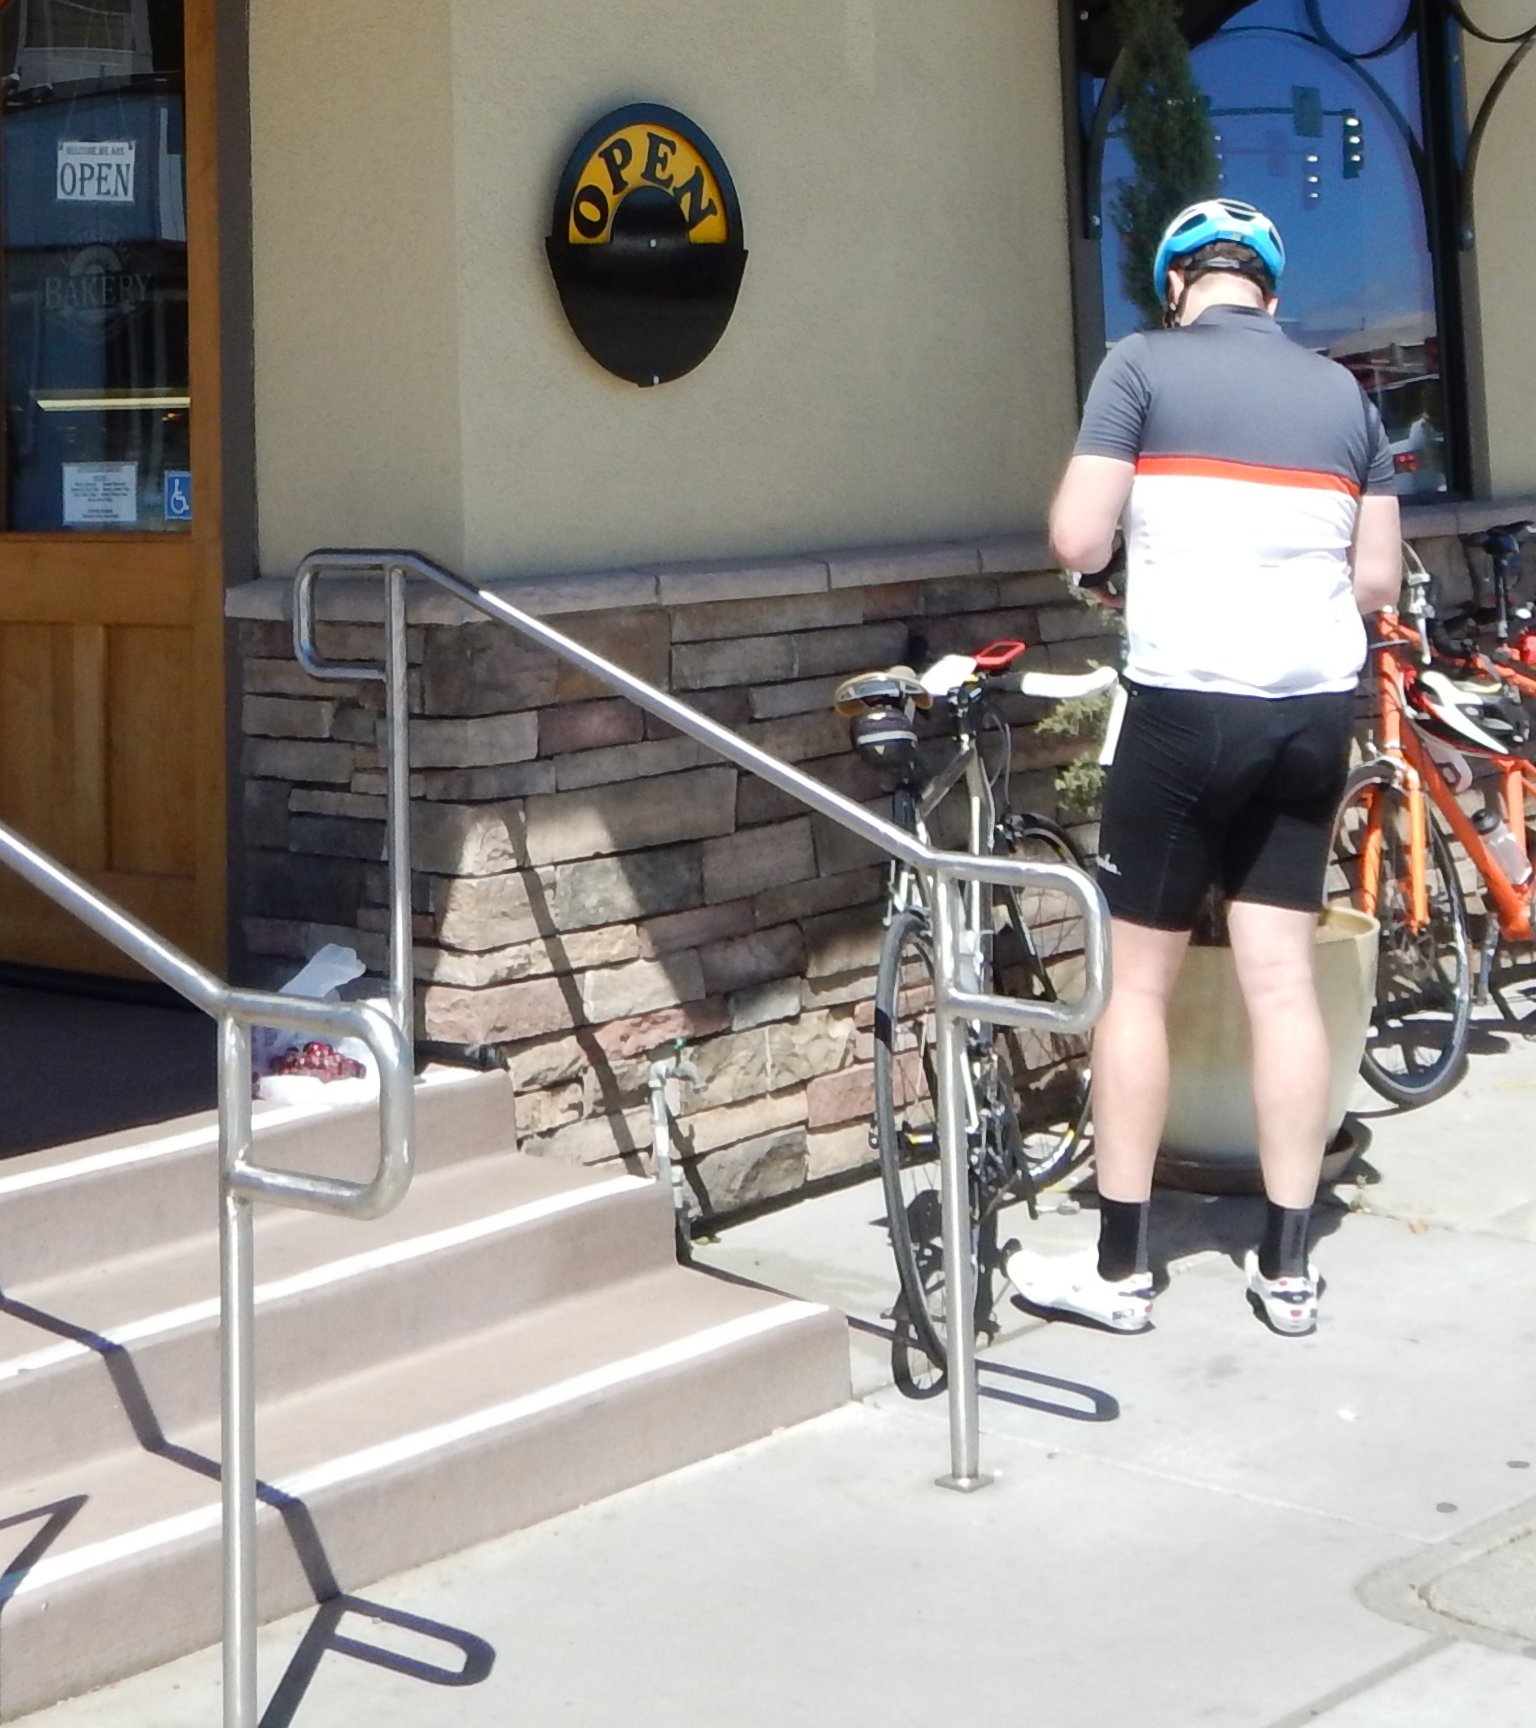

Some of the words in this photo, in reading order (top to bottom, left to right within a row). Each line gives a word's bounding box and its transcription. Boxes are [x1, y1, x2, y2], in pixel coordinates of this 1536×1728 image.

[60, 162, 131, 197] OPEN
[573, 132, 718, 239] OPEN
[44, 272, 152, 309] BAKERY
